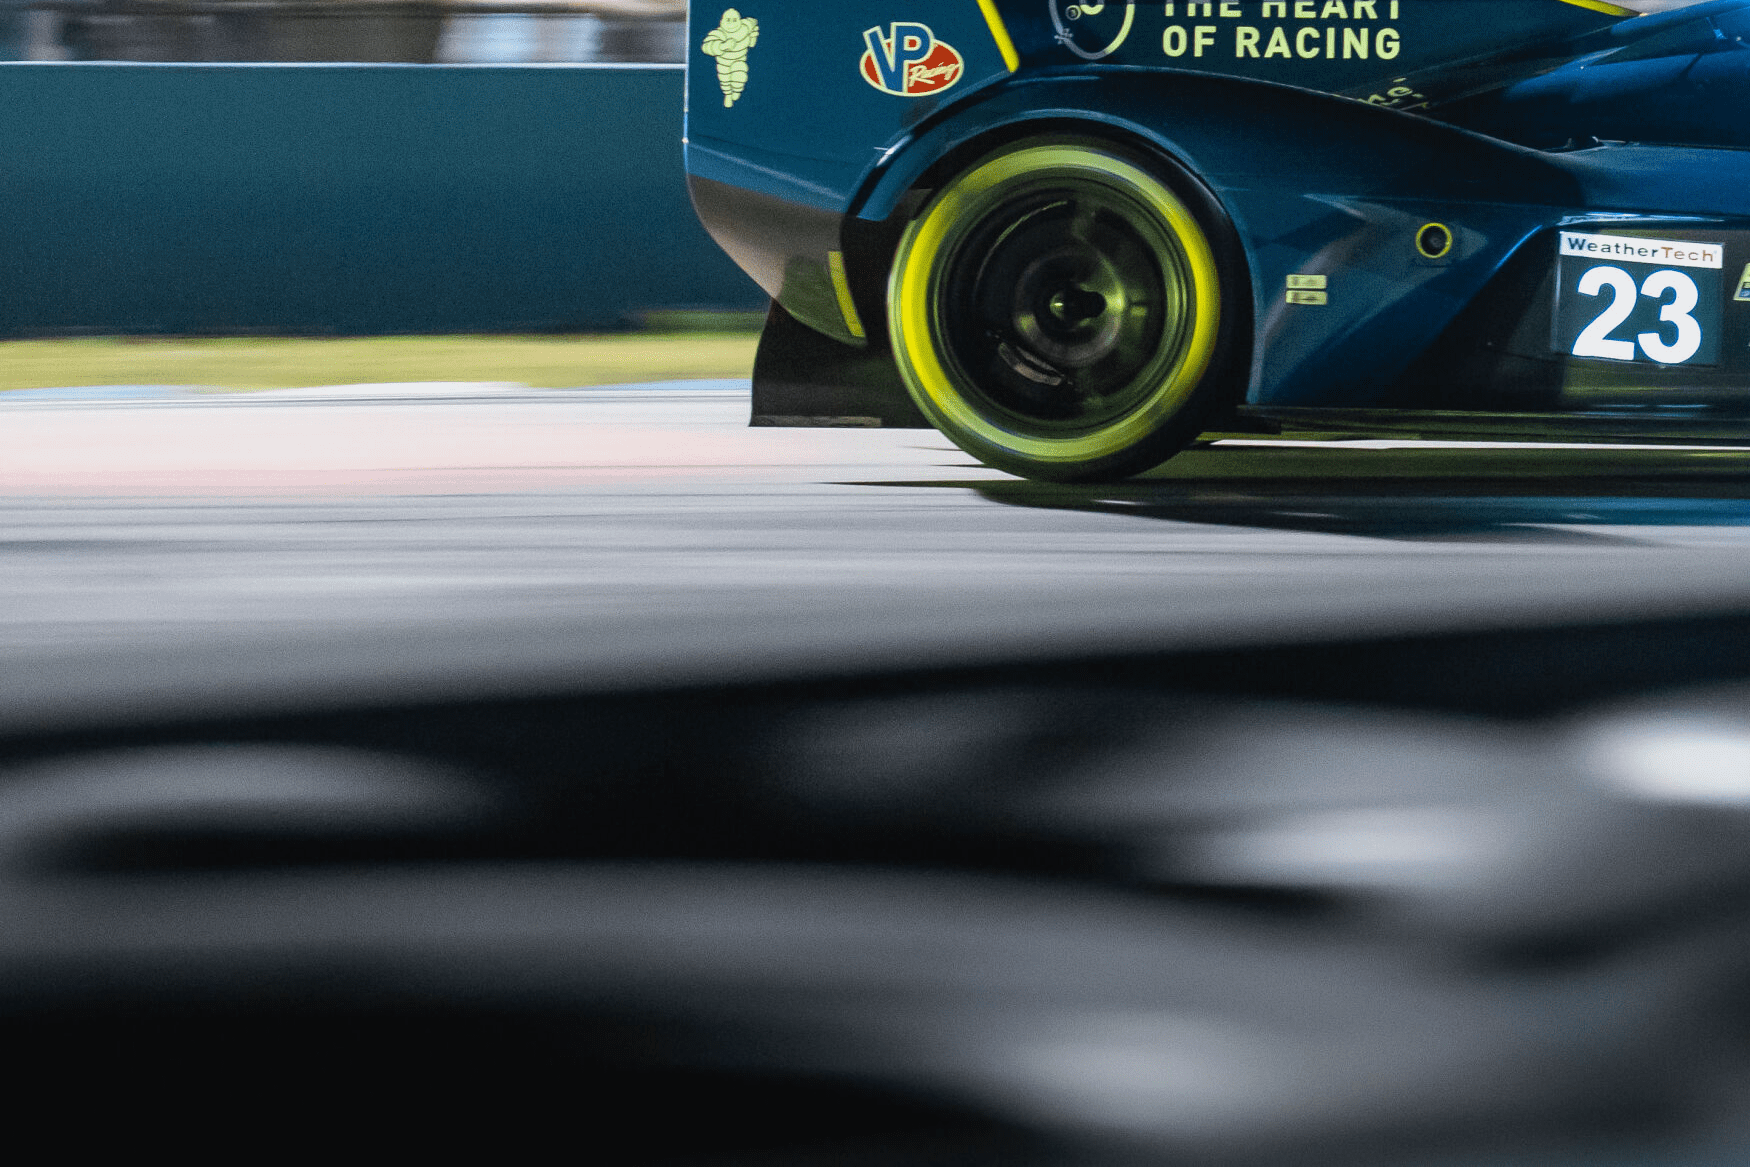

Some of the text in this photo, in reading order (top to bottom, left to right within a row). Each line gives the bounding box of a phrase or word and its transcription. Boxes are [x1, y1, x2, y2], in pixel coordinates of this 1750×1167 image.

[862, 21, 935, 94] VP
[1161, 25, 1401, 60] OF RACING
[908, 62, 960, 87] Racing
[1567, 237, 1714, 263] WeatherTech
[1571, 265, 1702, 365] 23
